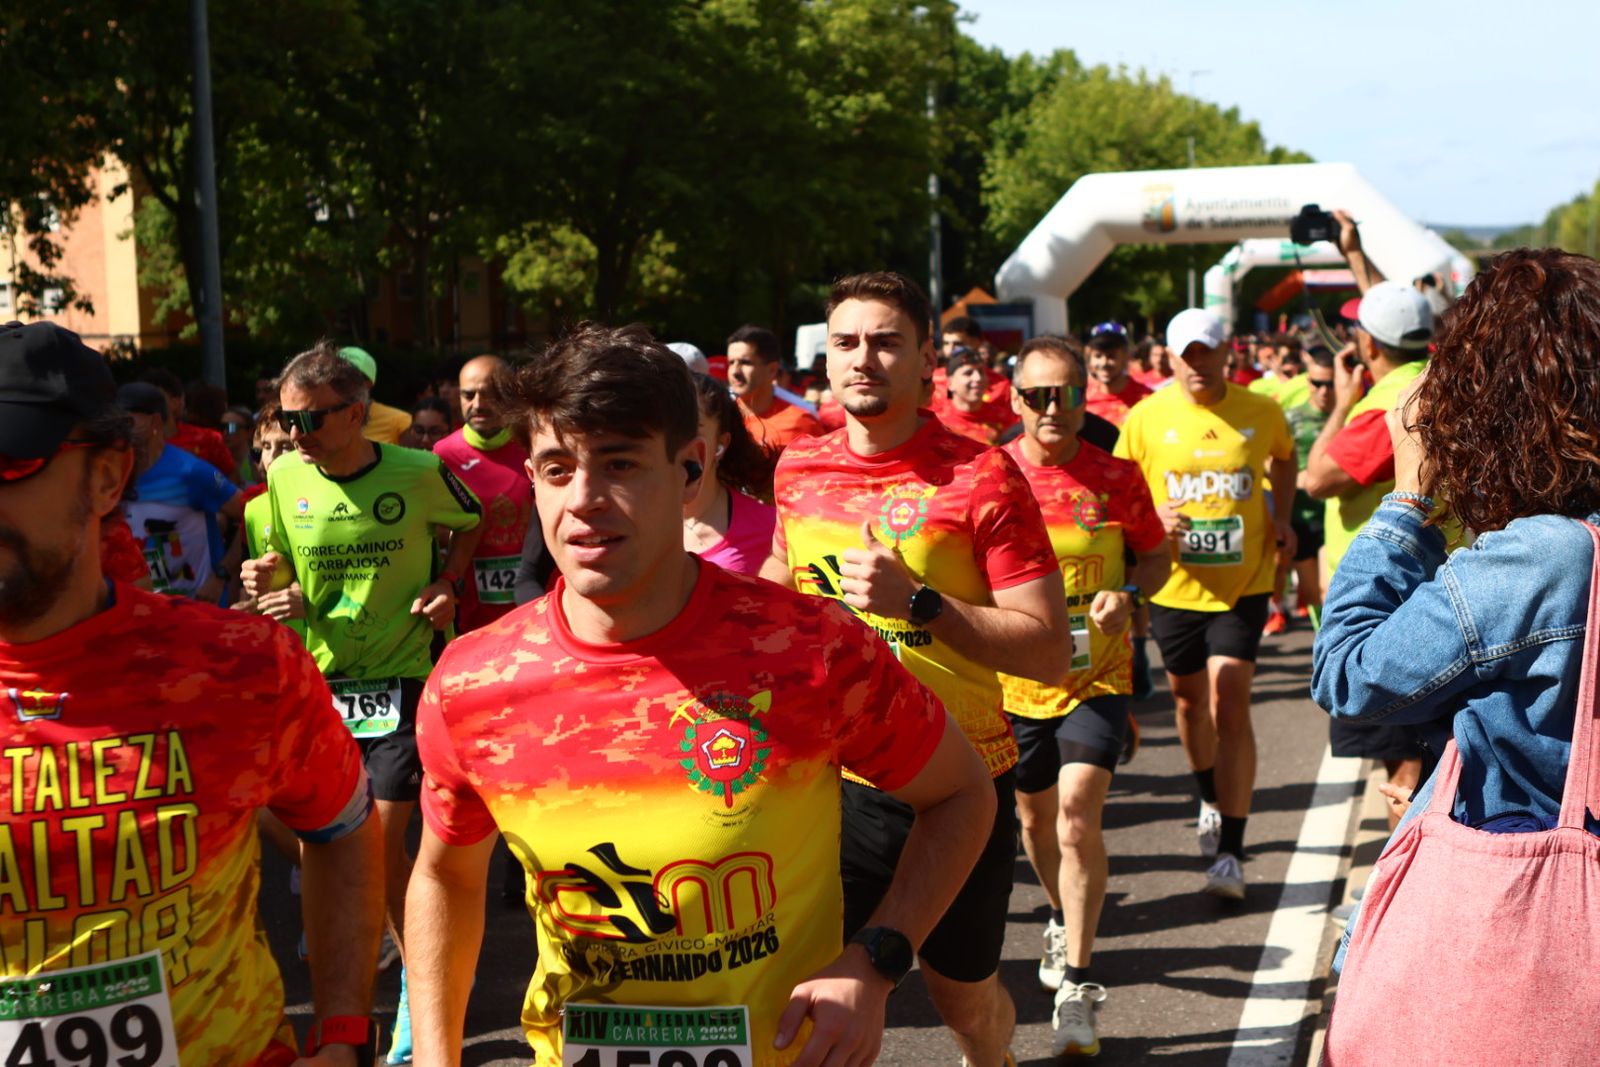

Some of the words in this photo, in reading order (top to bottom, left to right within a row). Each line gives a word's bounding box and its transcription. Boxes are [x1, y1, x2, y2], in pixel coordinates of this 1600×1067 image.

[1167, 470, 1253, 502] MADRID
[297, 538, 404, 557] CORRECAMINOS
[1188, 531, 1232, 553] 991
[308, 556, 390, 572] CARBAJOSA
[322, 573, 380, 582] SALAMANCA
[478, 569, 516, 590] 142
[340, 692, 391, 719] 769
[3, 731, 194, 814] TALEZA
[645, 912, 776, 954] CIVICO-MILITAR
[725, 925, 780, 970] 2026
[0, 986, 101, 1016] CARRERA
[5, 1003, 163, 1067] 499
[567, 1010, 610, 1040] XIV
[613, 1011, 642, 1026] SAN
[655, 1011, 741, 1027] FERNANDO
[612, 1026, 697, 1042] CARRERA
